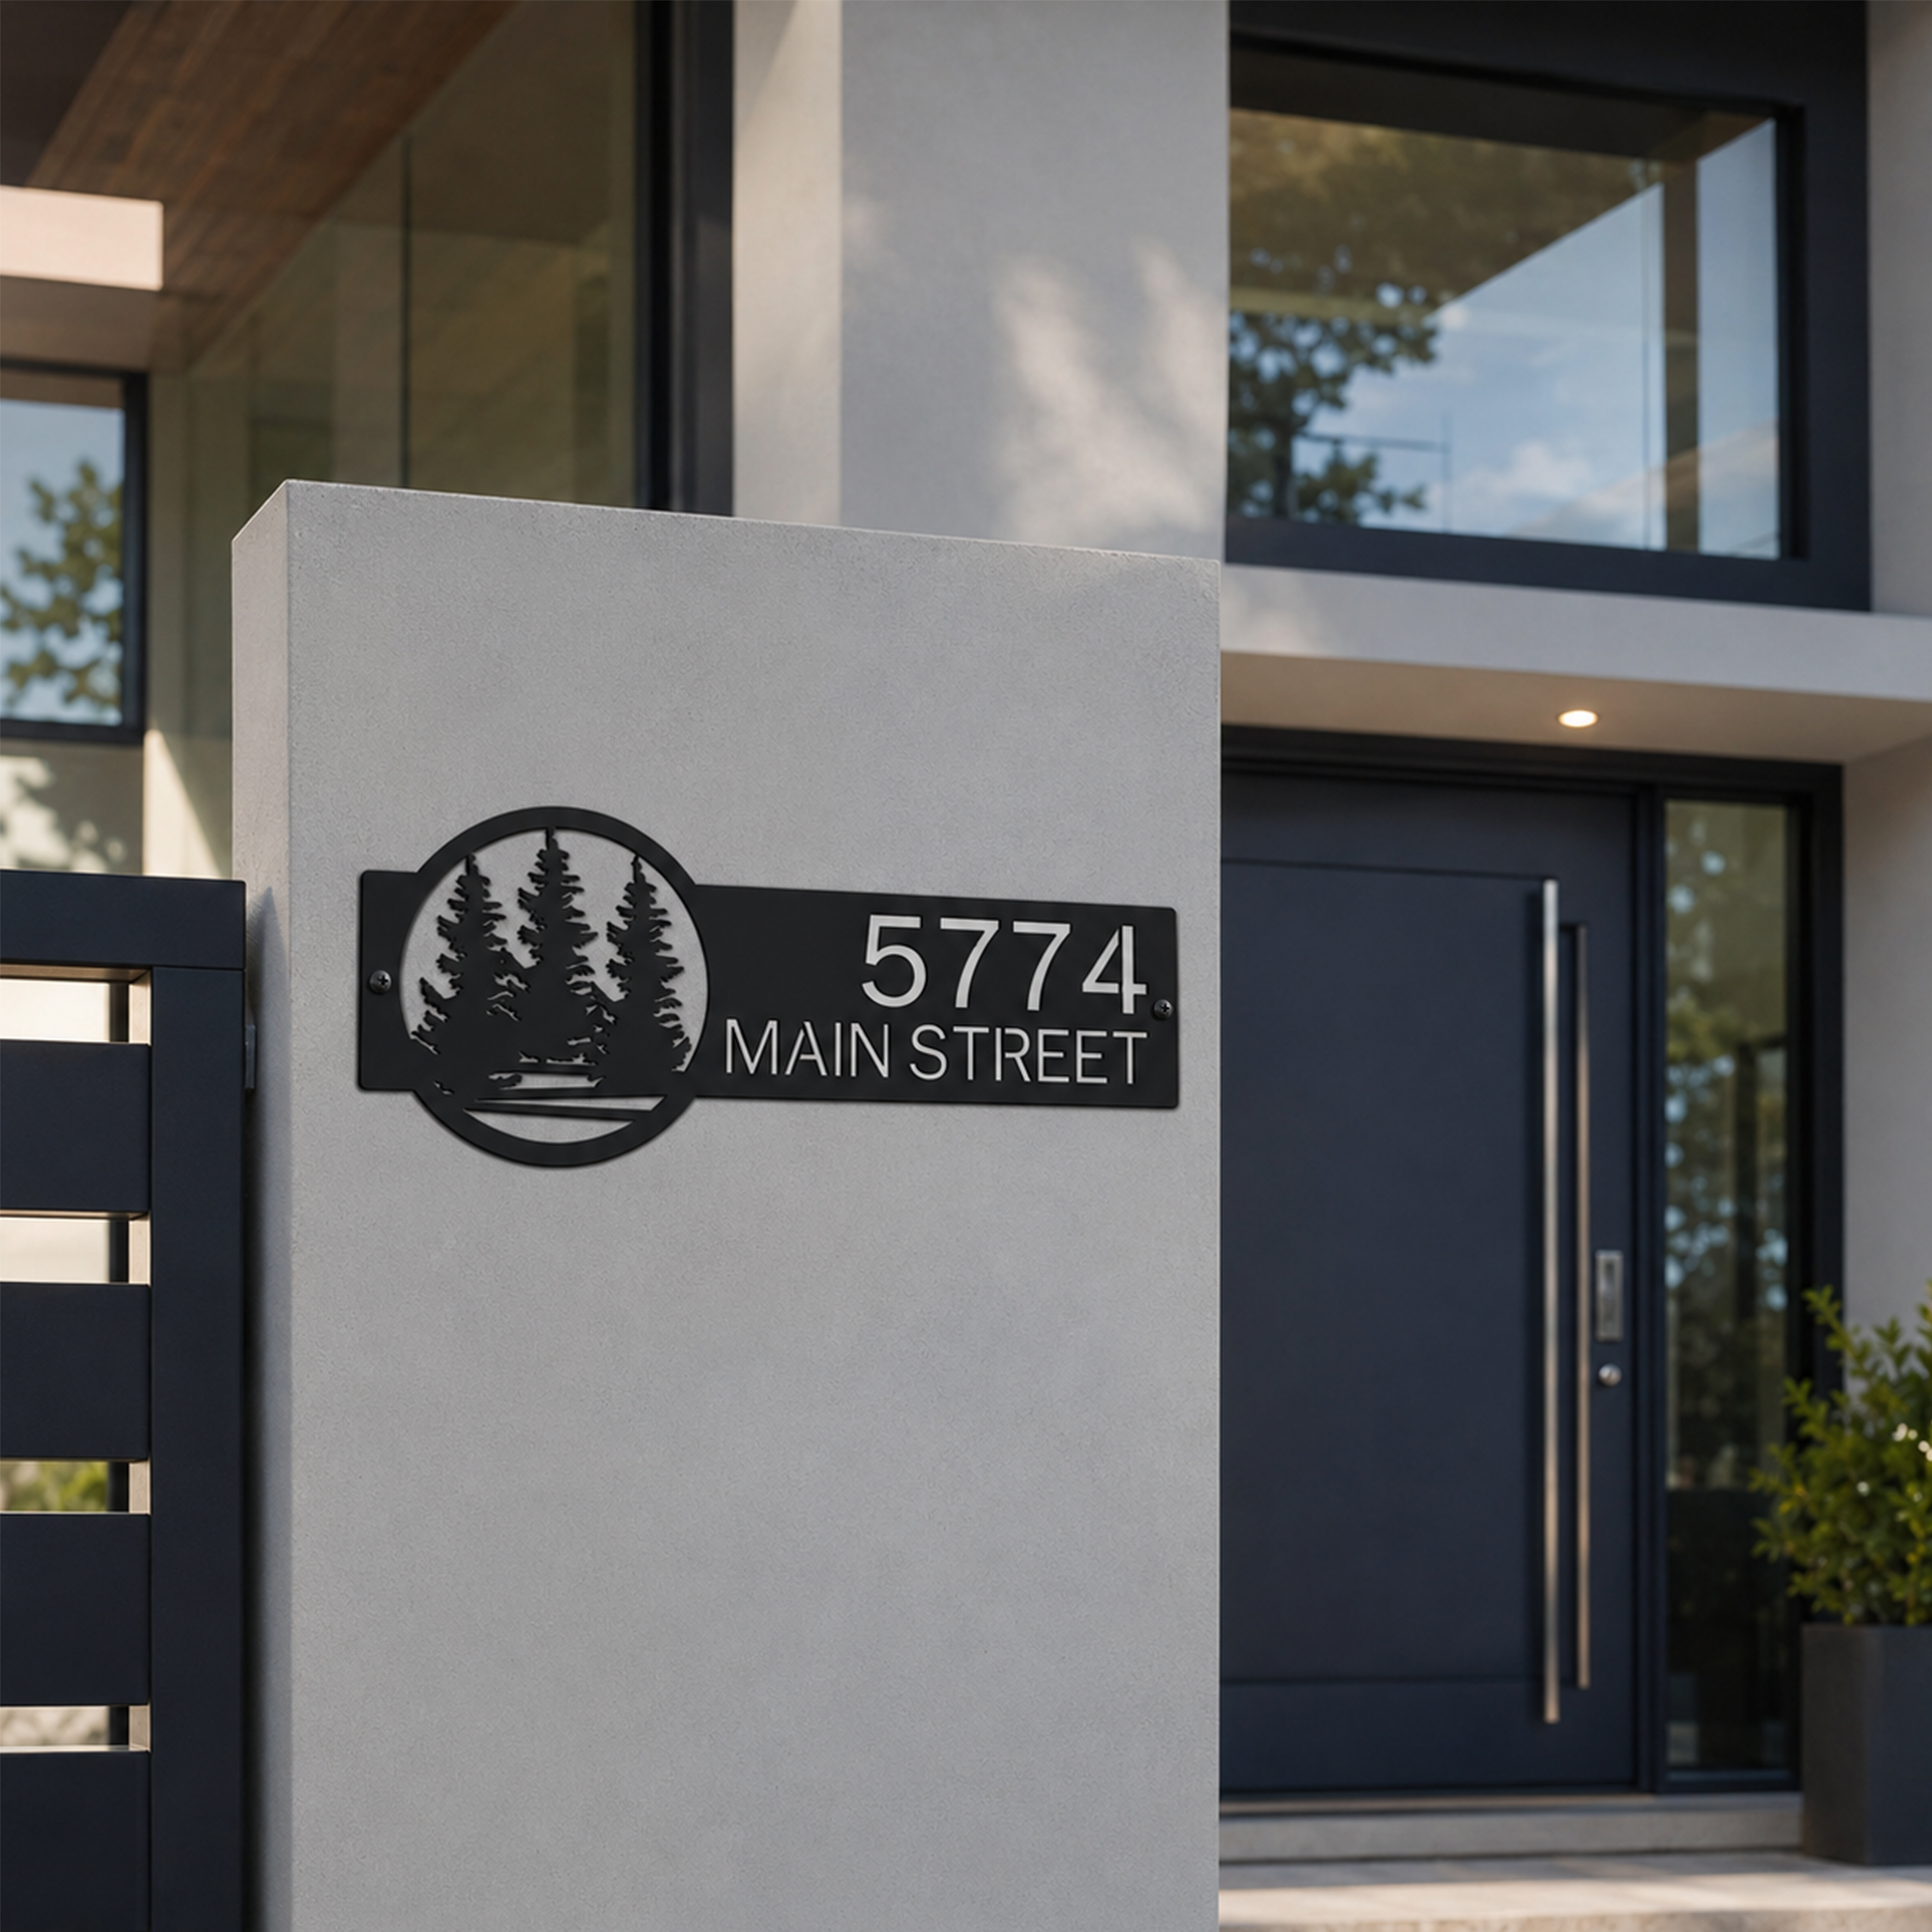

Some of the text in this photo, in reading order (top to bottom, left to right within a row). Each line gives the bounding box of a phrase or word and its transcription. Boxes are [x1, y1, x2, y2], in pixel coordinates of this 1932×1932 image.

[862, 914, 1147, 1014] 5774
[726, 1019, 1148, 1085] MAIN STREET
